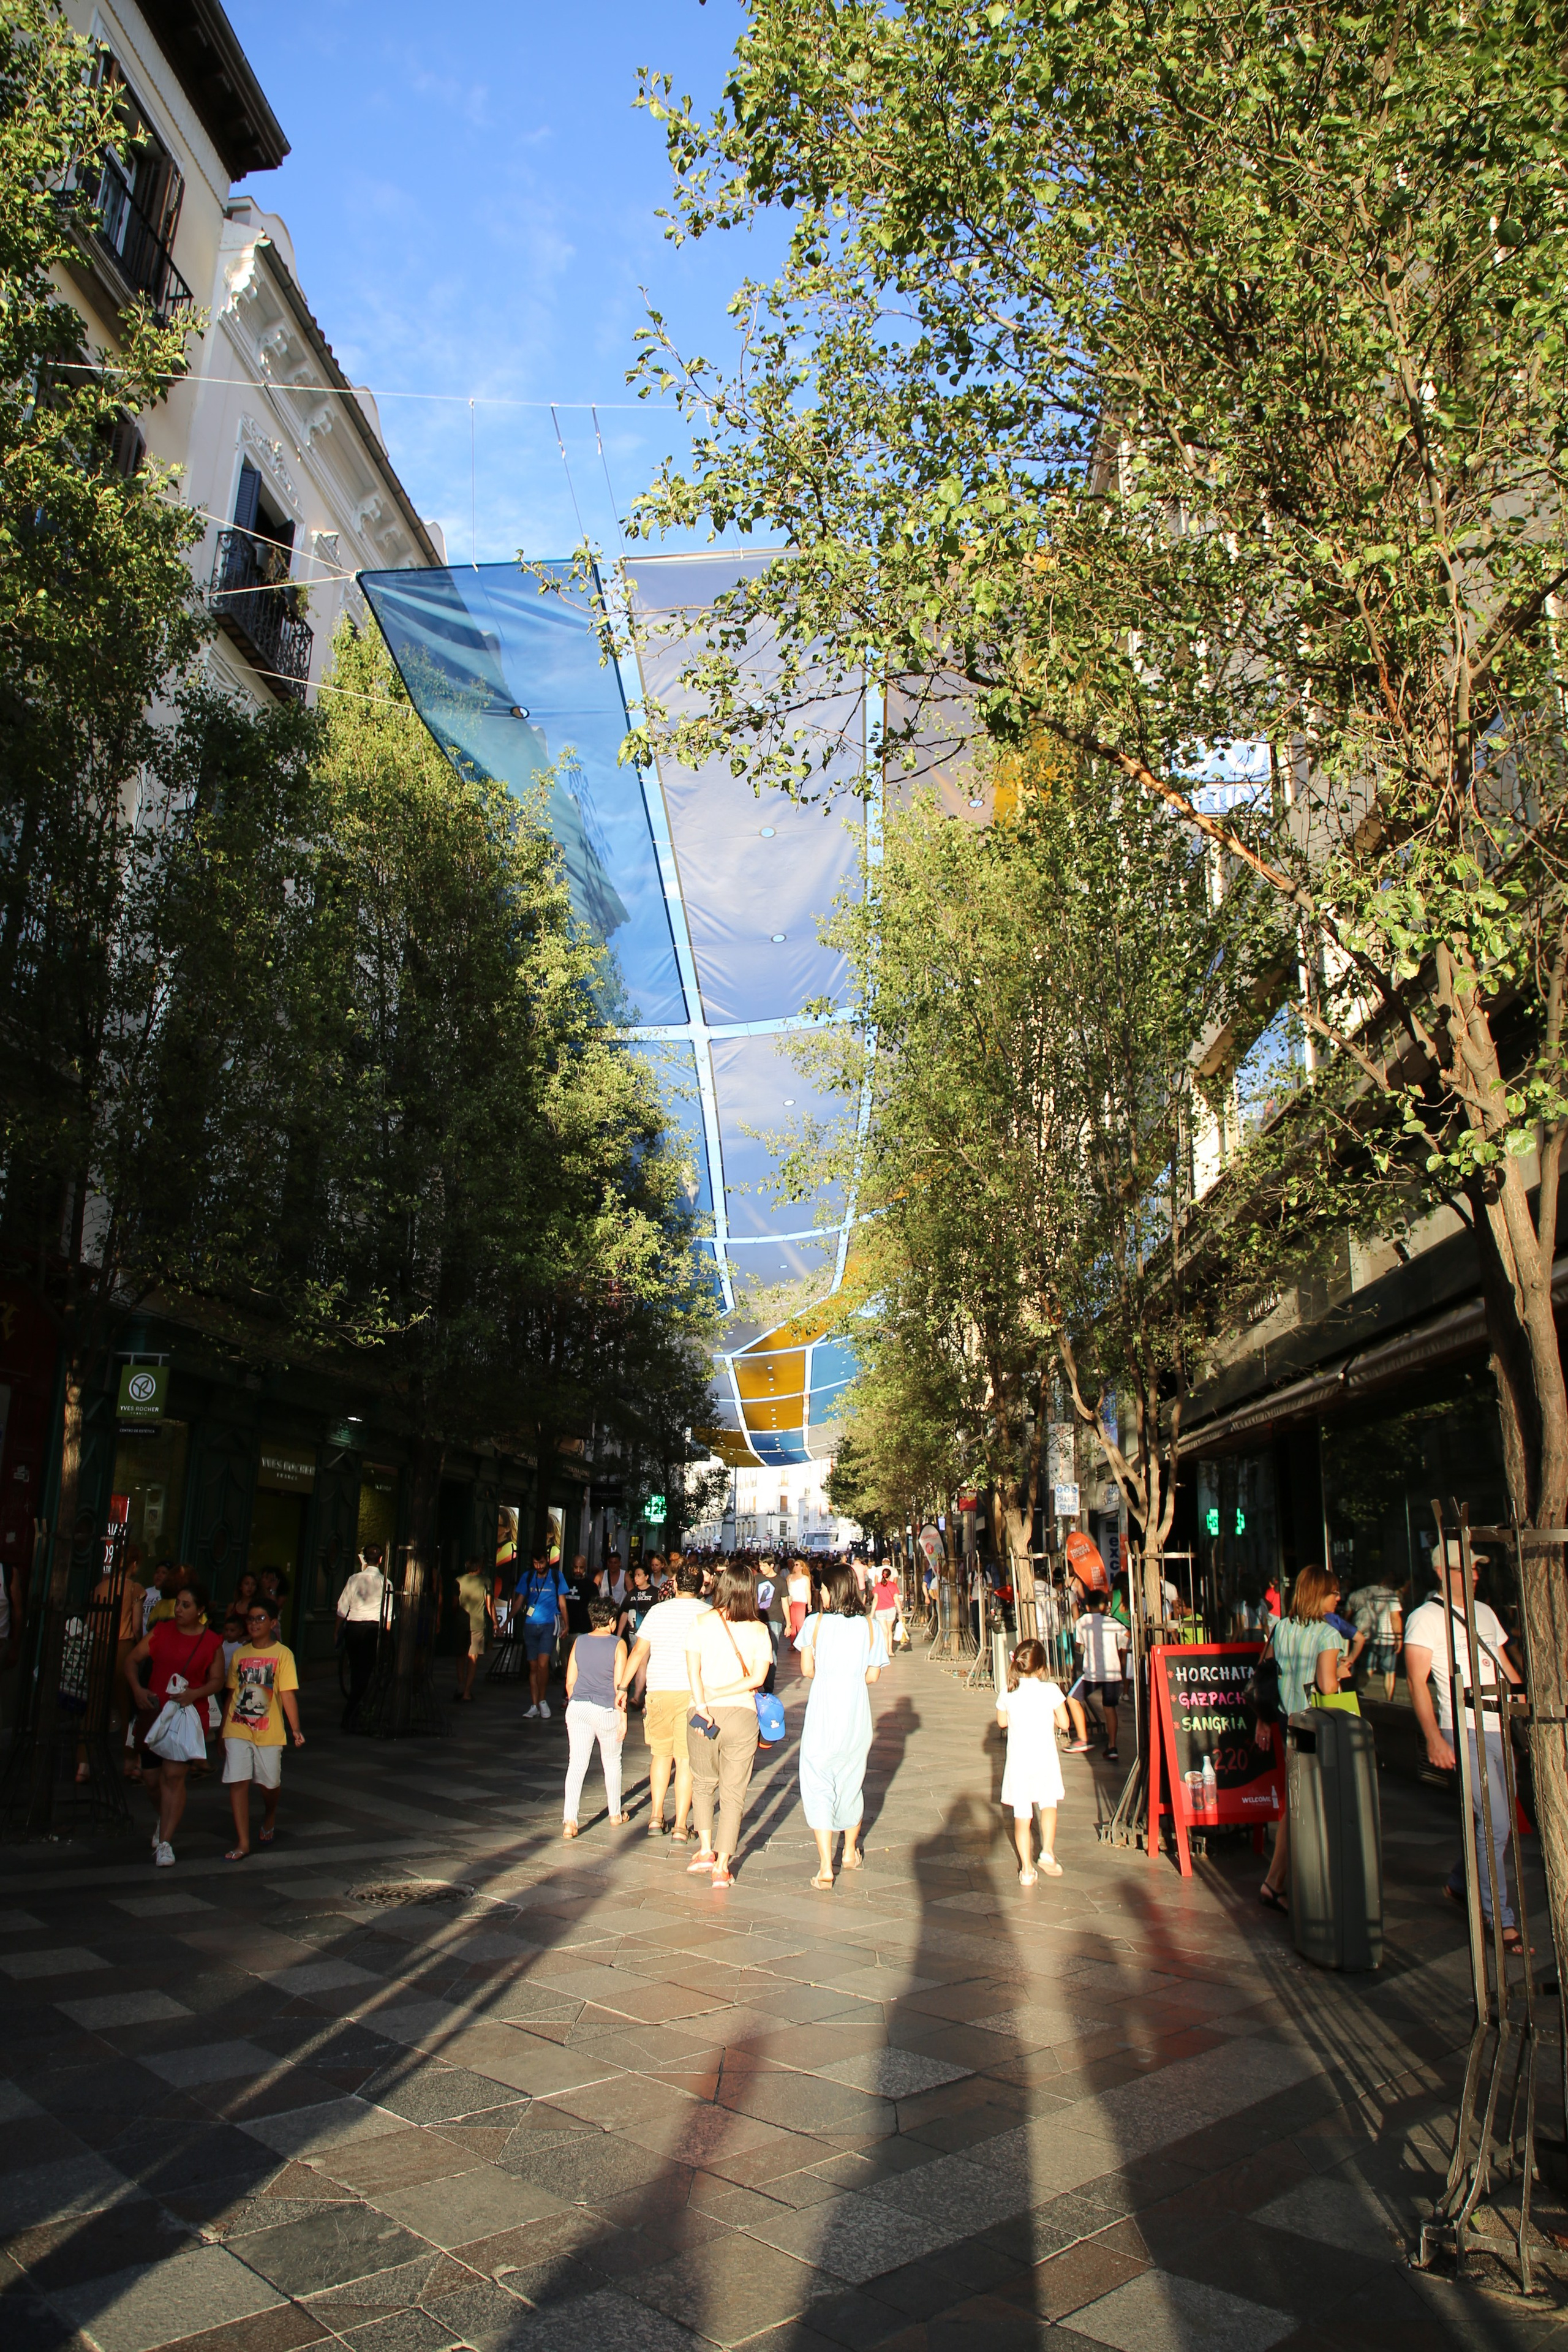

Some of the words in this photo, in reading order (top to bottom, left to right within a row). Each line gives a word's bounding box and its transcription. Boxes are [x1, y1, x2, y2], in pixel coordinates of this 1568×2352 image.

[1175, 1665, 1255, 1682] HORCHATA
[1178, 1691, 1246, 1709] GAZPACH
[1241, 1795, 1272, 1804] WELCOME
